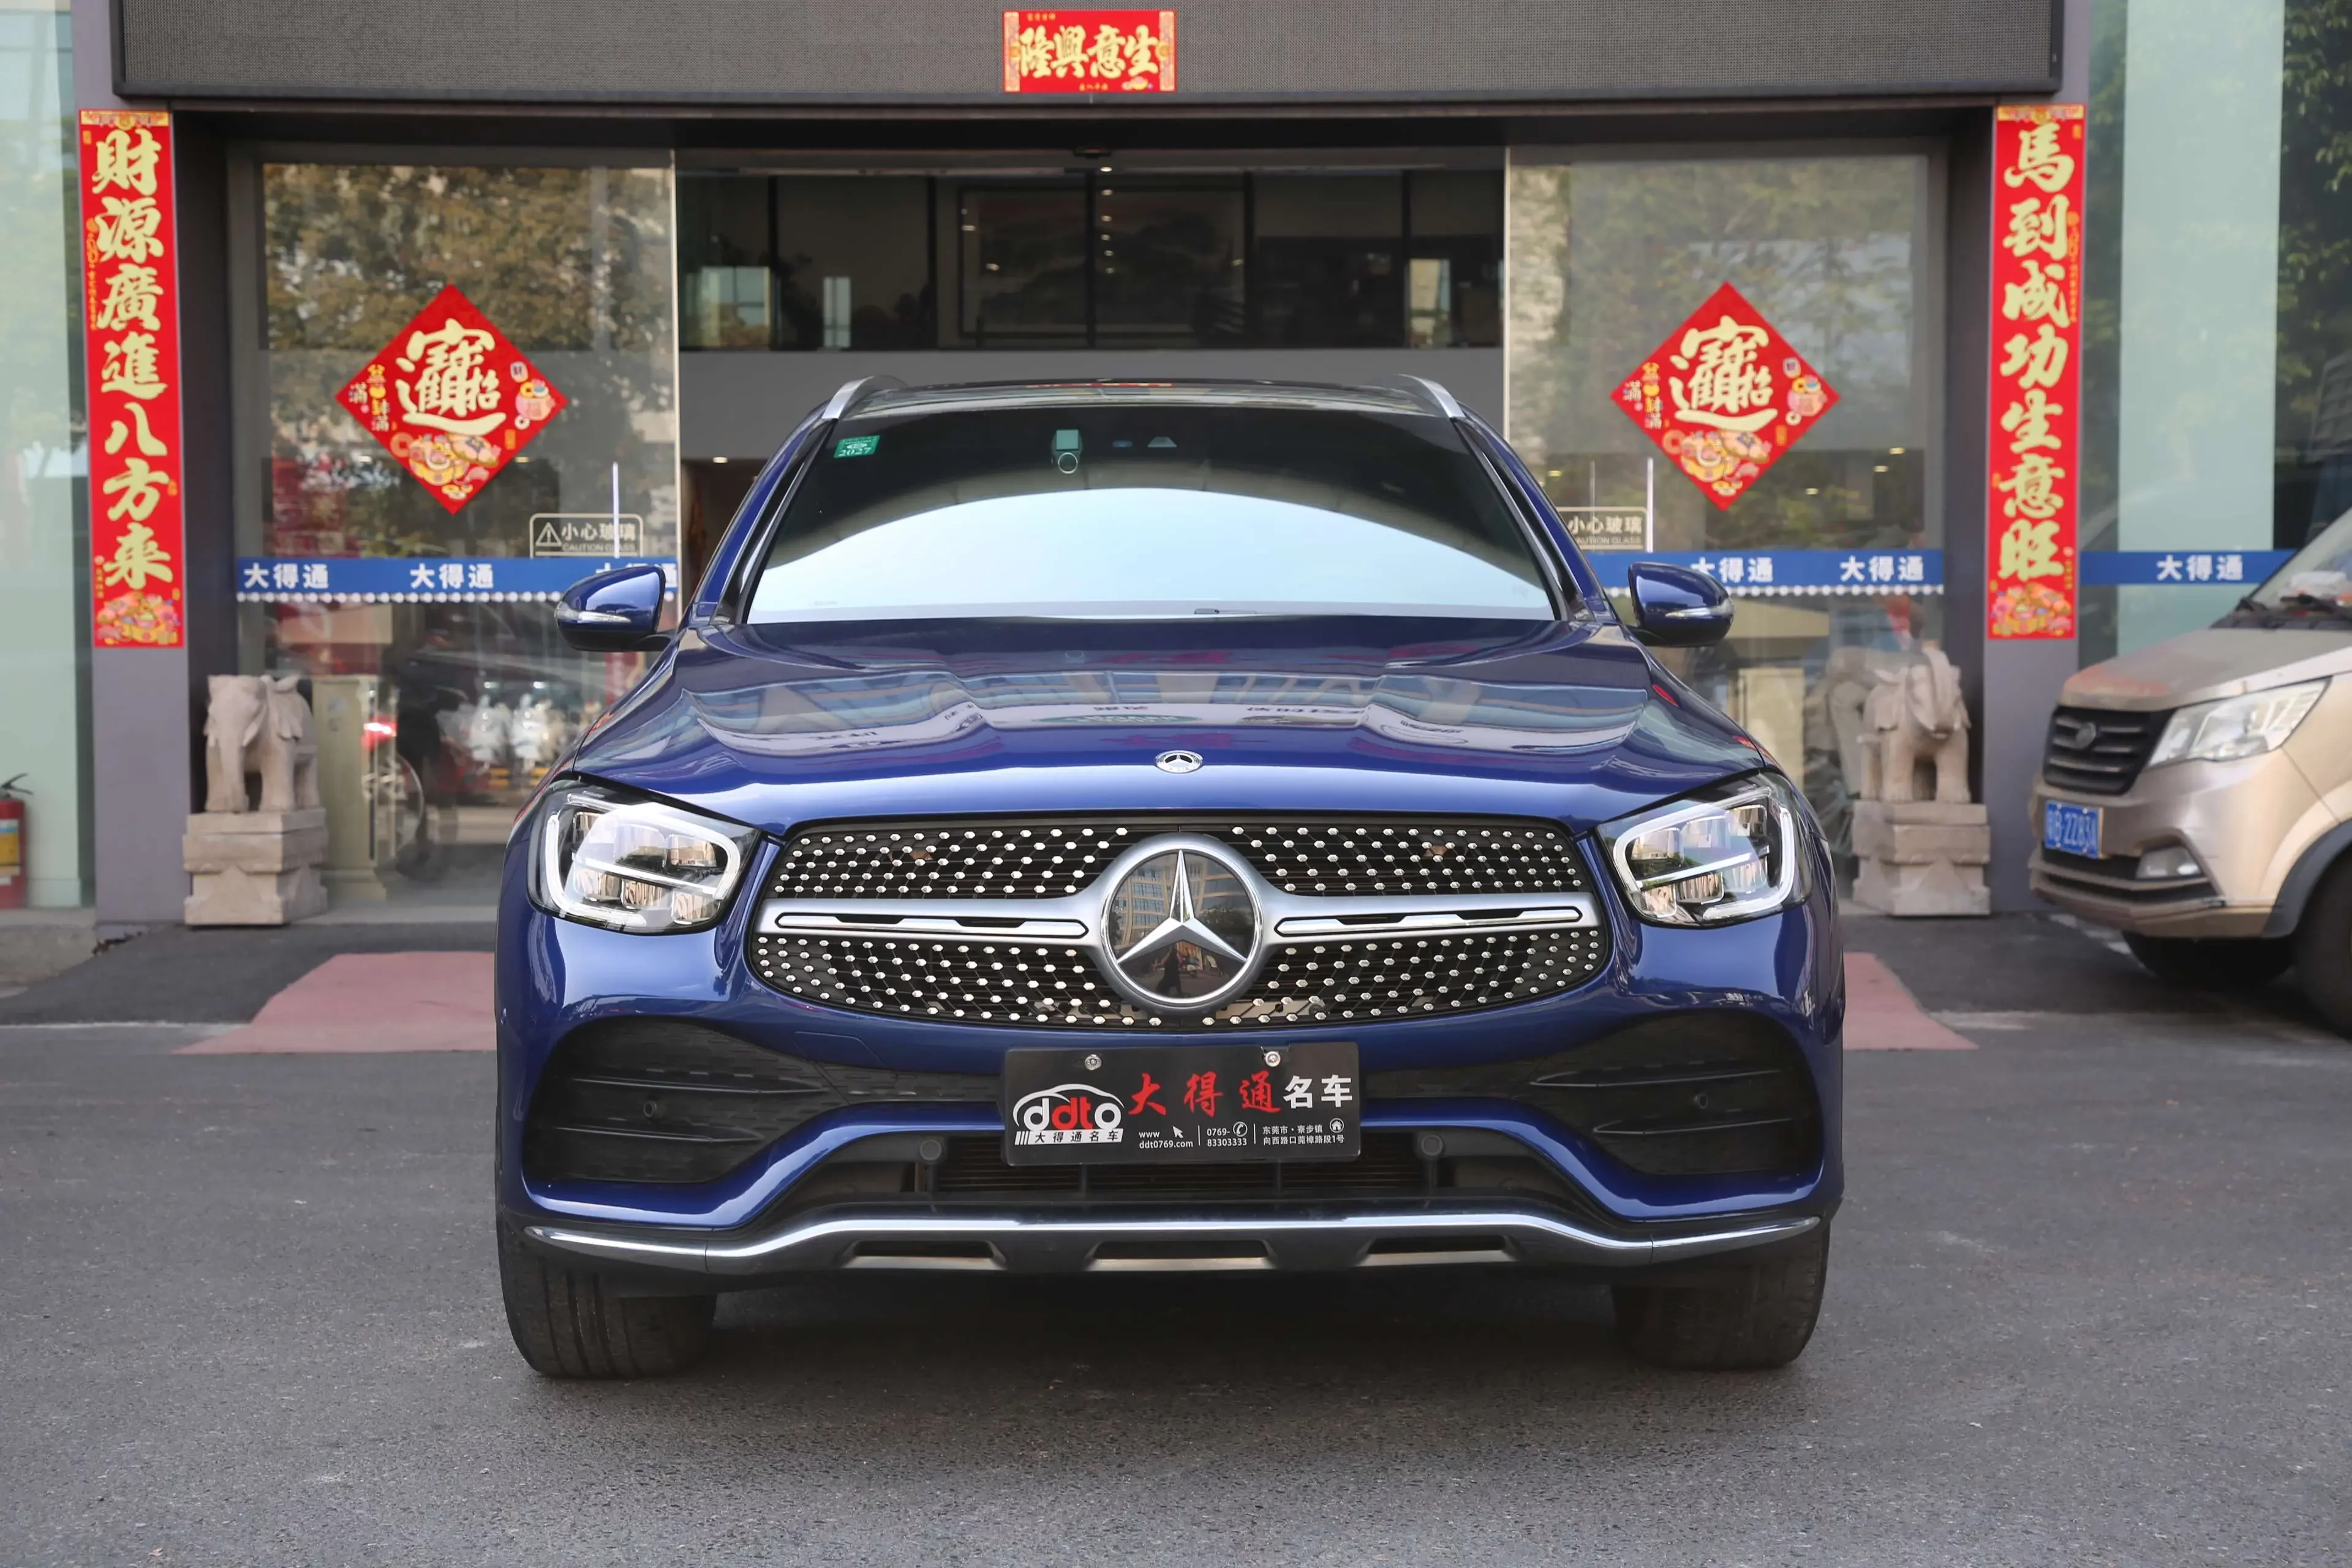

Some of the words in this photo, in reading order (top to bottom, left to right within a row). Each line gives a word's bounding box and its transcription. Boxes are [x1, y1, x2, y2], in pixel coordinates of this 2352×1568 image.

[838, 447, 872, 457] 2027
[1567, 516, 1642, 535] 小心玻璃
[562, 543, 603, 552] CAUTION
[605, 543, 636, 552] GASS
[1691, 556, 1773, 582] 大得通
[1839, 556, 1924, 582] 大得通
[2157, 554, 2244, 581] 大得通
[244, 563, 329, 589] 大得通
[410, 563, 494, 589] 大得通
[1035, 1131, 1119, 1144] 大得通名车
[1139, 1140, 1194, 1149] ddt0769.com
[1207, 1138, 1248, 1147] 83303333
[1263, 1134, 1344, 1145] 向西路口莞樟路段1号
